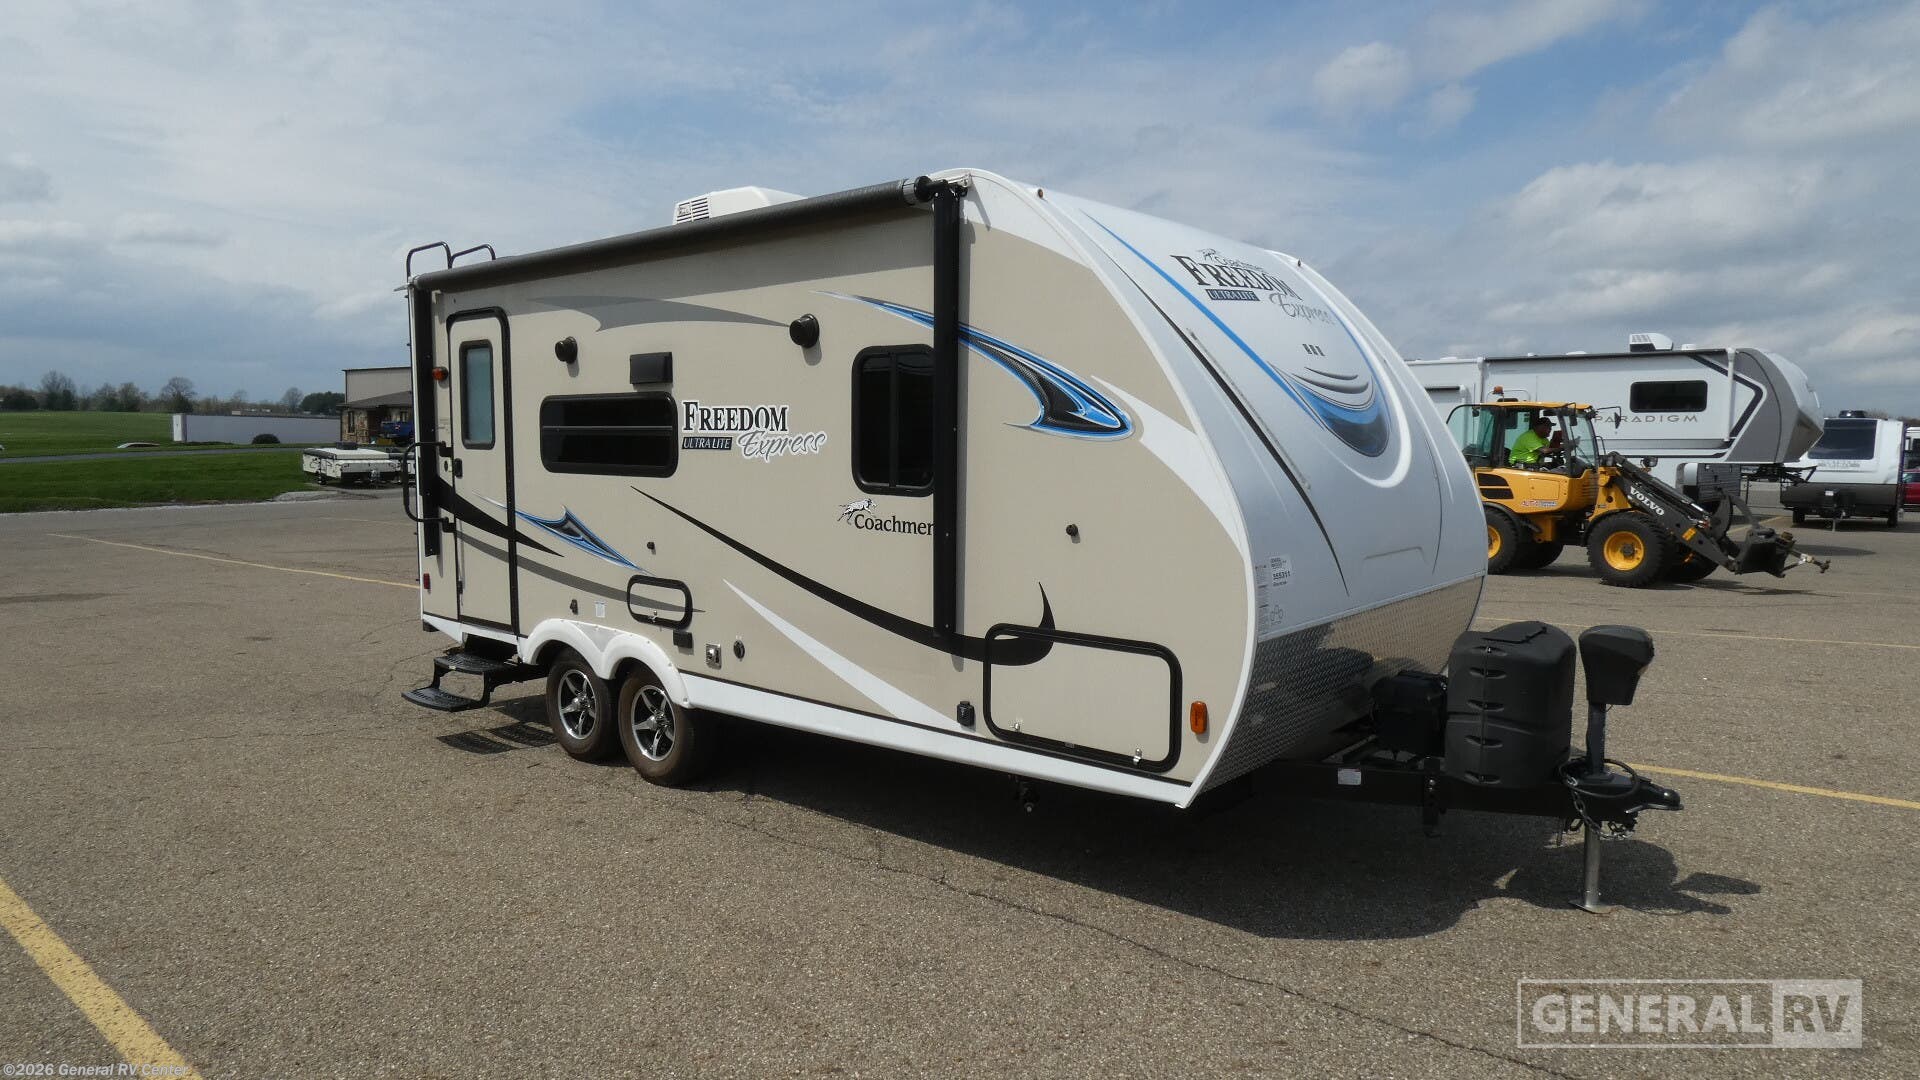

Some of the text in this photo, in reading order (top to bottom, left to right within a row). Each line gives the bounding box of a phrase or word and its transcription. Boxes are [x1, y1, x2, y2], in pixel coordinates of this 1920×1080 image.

[1170, 254, 1303, 301] FREEDOM
[683, 401, 788, 432] FREEDOM
[1595, 414, 1698, 423] PARADIGM
[738, 430, 826, 460] Express
[1630, 486, 1664, 515] VOLVO
